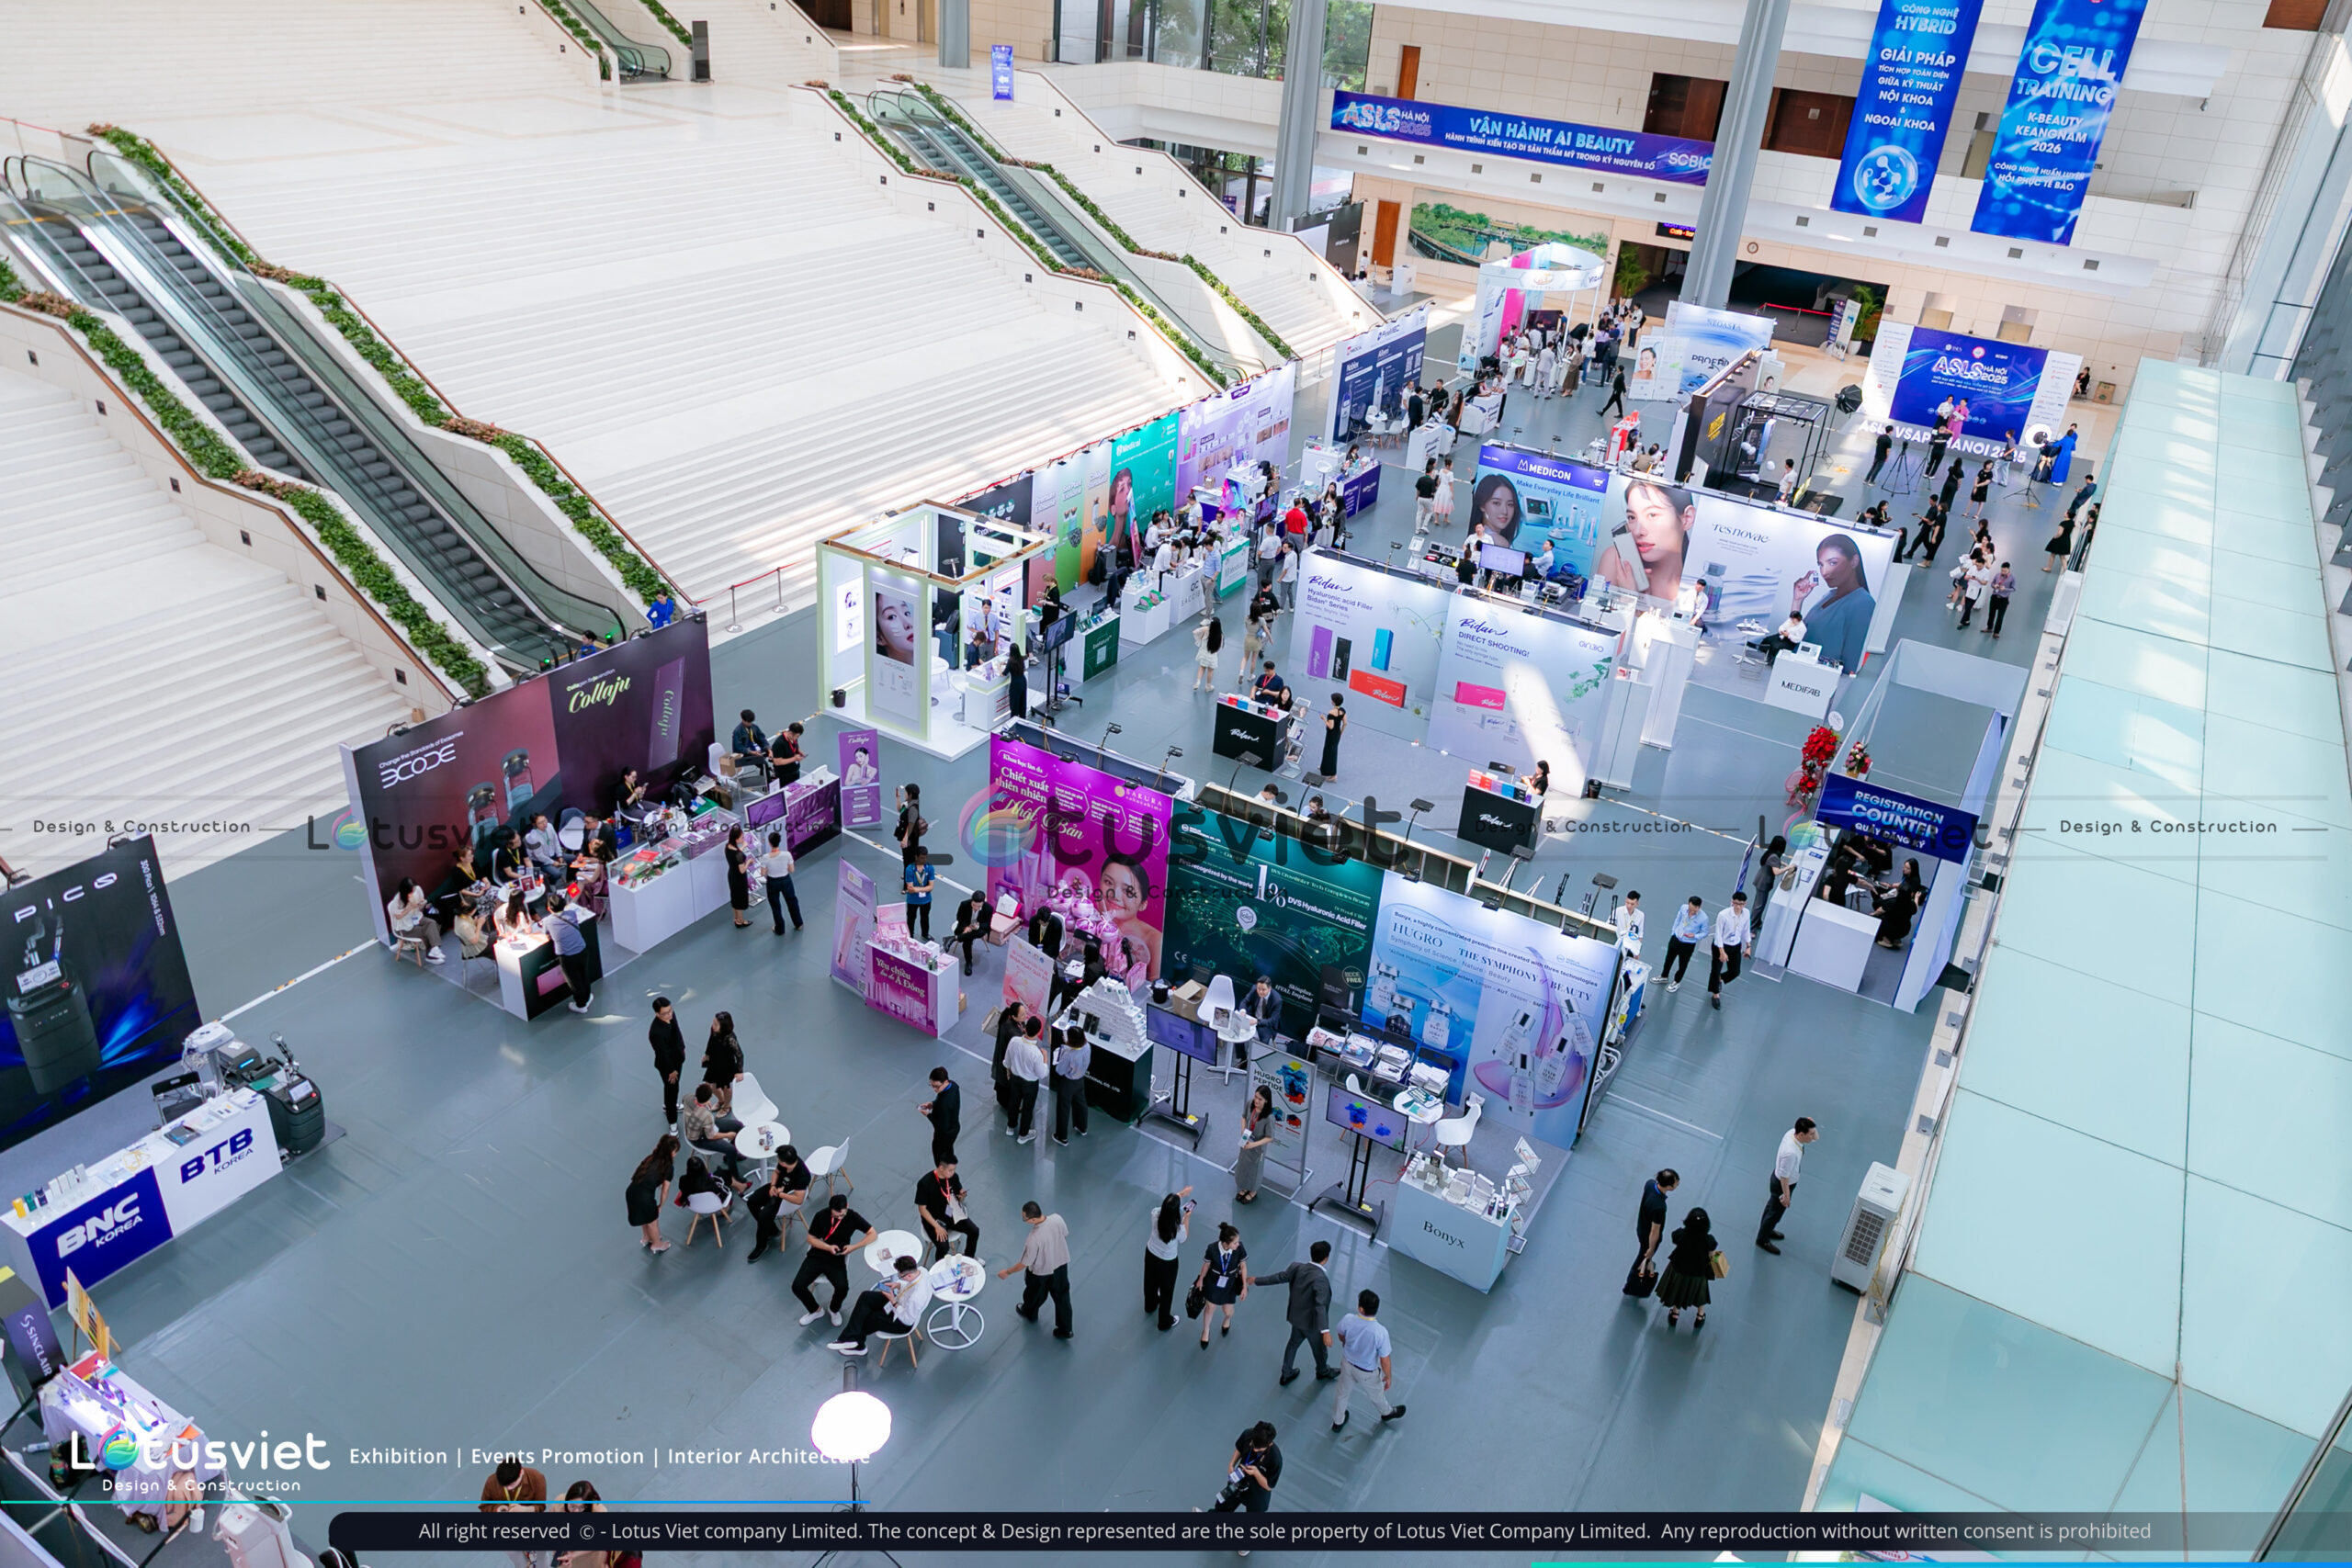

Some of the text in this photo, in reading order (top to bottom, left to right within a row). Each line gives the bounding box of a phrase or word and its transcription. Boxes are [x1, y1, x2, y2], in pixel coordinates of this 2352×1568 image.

[1902, 3, 1960, 19] CÔNG NGHỆ
[1895, 16, 1957, 35] HYBRID
[1879, 64, 1894, 73] TÍCH
[1881, 46, 1956, 67] GIẢI PHÁP
[2030, 42, 2116, 81] CELL
[1878, 76, 1899, 87] GIỮA
[1916, 80, 1944, 93] THUẬT
[2017, 77, 2112, 106] TRAINING
[1879, 89, 1934, 106] NỘI KHOA
[1342, 101, 1430, 132] ASLS HÀ NỘI
[1399, 121, 1432, 137] 2025
[1864, 114, 1936, 131] NGOẠI KHOA
[2028, 111, 2084, 128] K-BEAUTY
[1470, 117, 1635, 155] VẬN HÀNH AI BEAUTY
[2015, 125, 2087, 143] KEANGNAM
[1445, 132, 1465, 143] HÀNH
[1465, 135, 1486, 146] TRÌNH
[1503, 141, 1517, 152] TẠO
[1519, 144, 1527, 152] DI
[1577, 152, 1600, 164] TRONG
[1613, 158, 1643, 169] NGUYÊN
[2031, 141, 2062, 155] 2026
[1995, 162, 2018, 172] CÔNG
[2054, 180, 2075, 191] BÀO
[1931, 355, 1984, 380] ASLS
[1981, 373, 2008, 385] 2025
[1529, 463, 1572, 481] MEDICON
[1516, 479, 1600, 504] Make Everyday Life Brilliant
[1307, 575, 1353, 592] Bidan
[1307, 587, 1341, 603] Hyaluronic
[1342, 597, 1356, 607] acid
[1357, 601, 1374, 612] Filler
[1329, 601, 1349, 612] Series
[1459, 618, 1509, 636] Bidan
[1458, 631, 1487, 645] DIRECT
[1487, 639, 1530, 659] SHOOTING!
[568, 676, 631, 714] Collaju
[1781, 680, 1822, 698] MEDIFAB
[1001, 766, 1050, 793] Chiết xuất
[1020, 787, 1047, 805] nhiên
[1855, 791, 1945, 825] REGISTRATION
[1852, 804, 1939, 839] COUNTER
[1192, 863, 1253, 889] recognized world
[1287, 896, 1368, 931] DVS Hyaluronic Acid Filler
[1393, 922, 1442, 948] HUGRO
[1391, 935, 1512, 984] Symphony Science Nature Beauty
[1418, 919, 1434, 931] highly
[1435, 926, 1472, 943] concentrated
[1472, 939, 1497, 953] premium
[1498, 947, 1508, 955] line
[1508, 952, 1531, 964] created
[1531, 959, 1544, 968] with
[1544, 963, 1560, 975] three
[1560, 969, 1599, 988] technologies
[1346, 976, 1363, 985] FREE
[1458, 947, 1593, 1002] THE SYMPHONY BEAUTY
[1253, 1076, 1283, 1092] PEPTIDE
[1254, 1069, 1282, 1084] HUGRO
[180, 1127, 254, 1184] BTB
[214, 1147, 254, 1175] KOREA
[56, 1191, 141, 1258] BNC
[95, 1214, 143, 1248] KOREA
[1423, 1220, 1465, 1249] Bonyx
[26, 1325, 54, 1377] SINCLAIR
